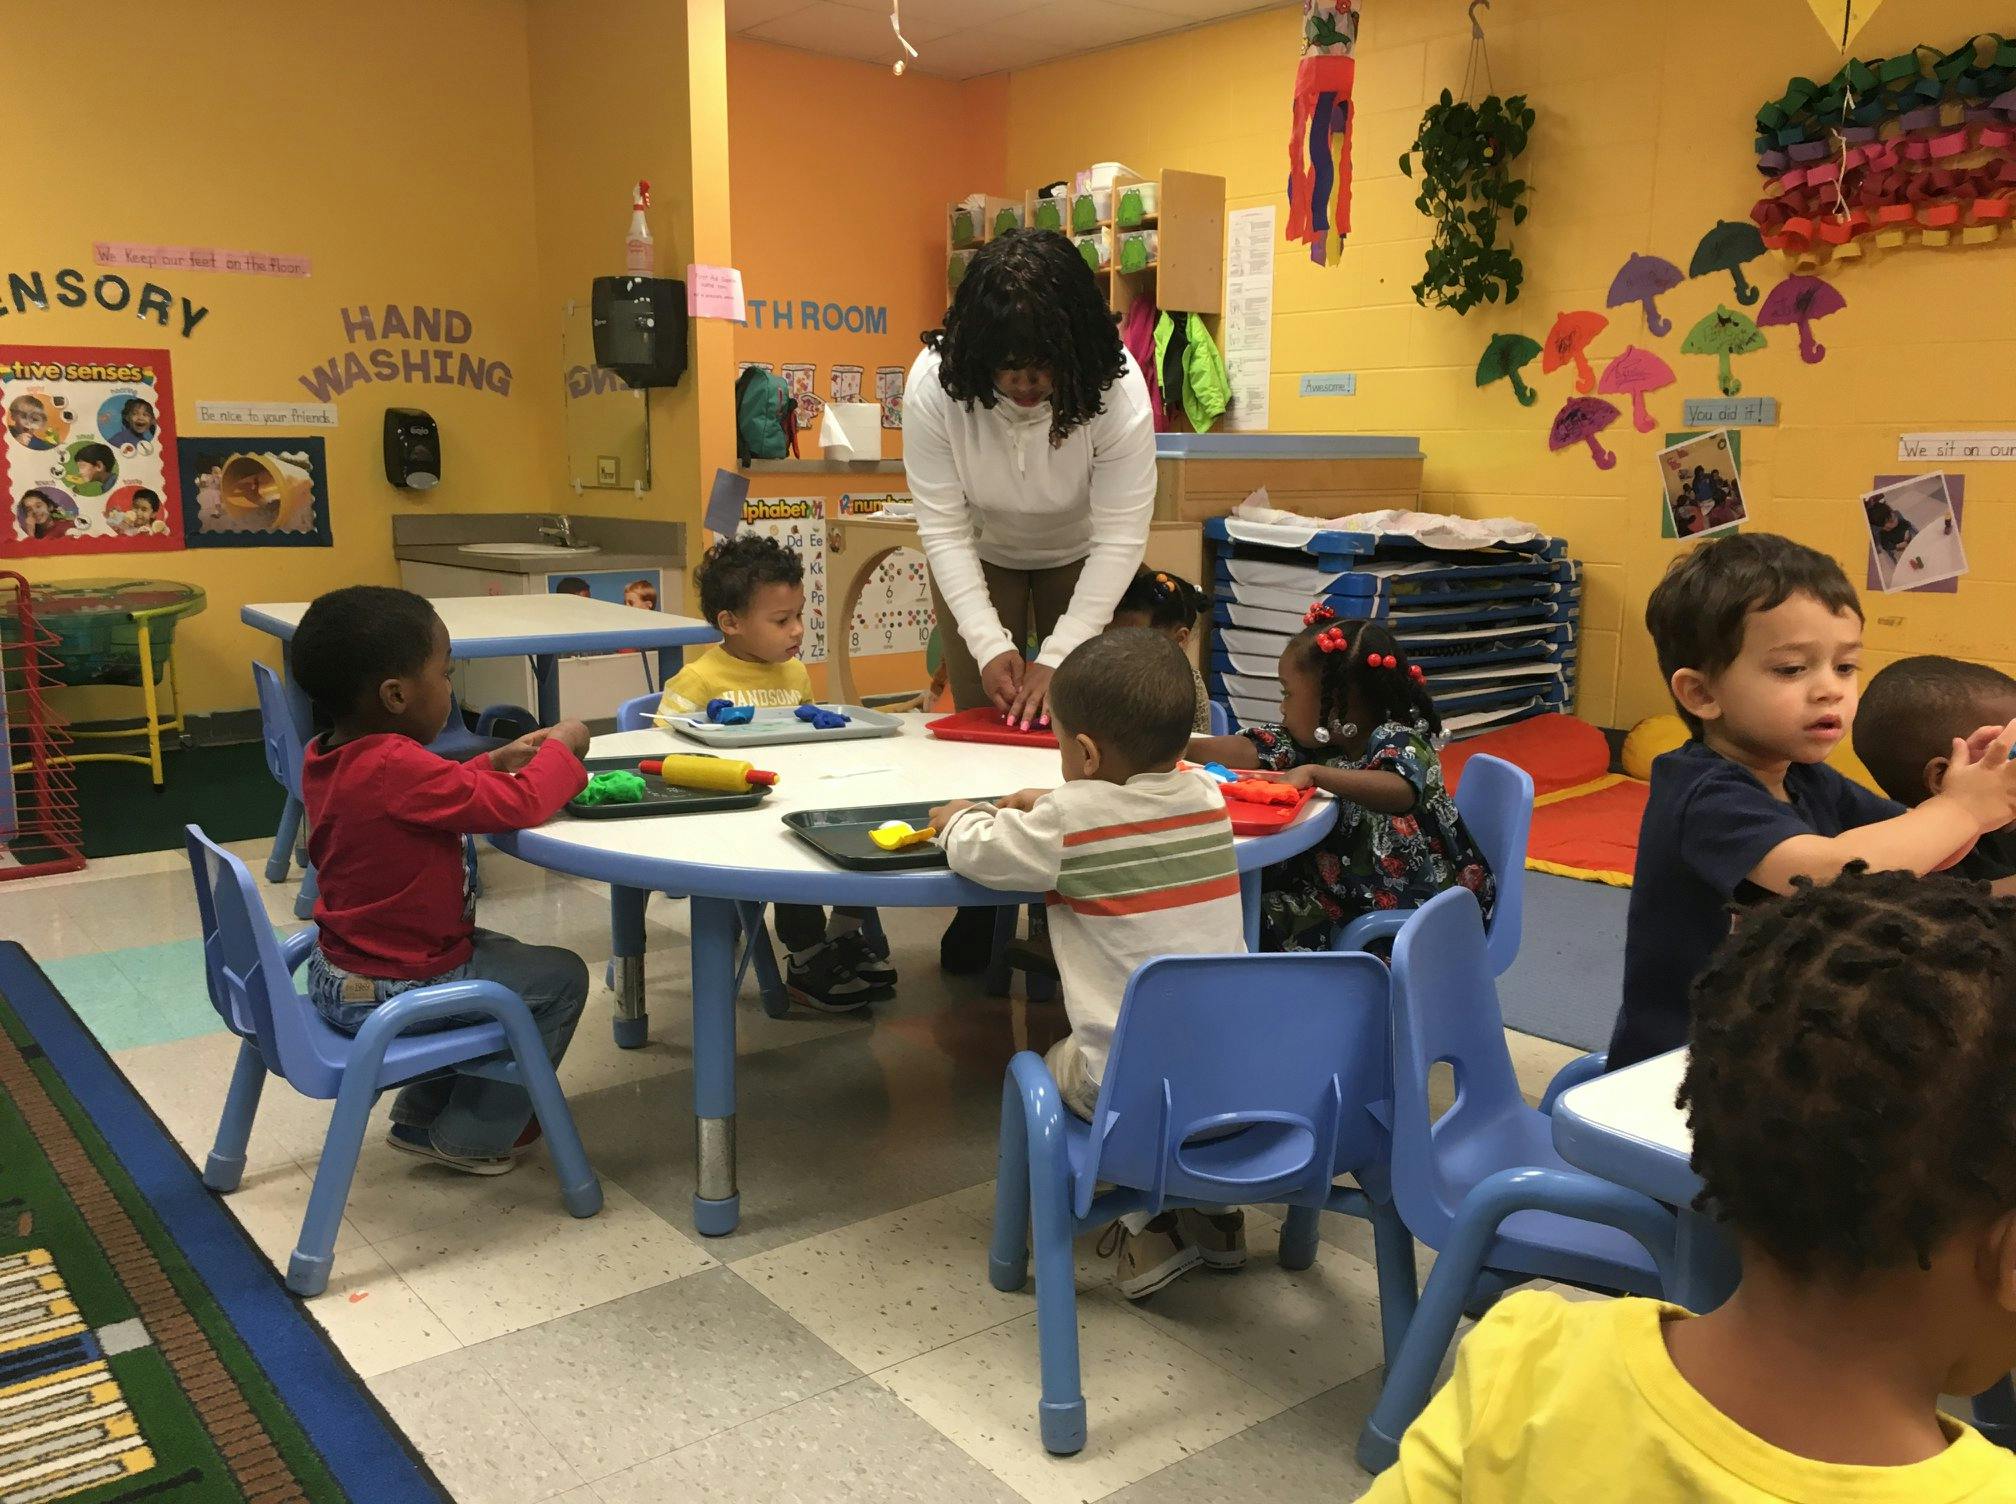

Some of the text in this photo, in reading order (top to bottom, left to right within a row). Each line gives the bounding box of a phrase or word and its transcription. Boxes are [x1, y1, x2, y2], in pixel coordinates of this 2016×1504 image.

[96, 245, 116, 261] We
[162, 256, 184, 267] our
[189, 251, 216, 268] feet
[226, 259, 242, 271] on
[244, 256, 267, 272] the
[341, 304, 472, 343] HAND
[65, 364, 144, 383] senses
[298, 349, 513, 403] WASHING
[201, 406, 215, 421] Be
[220, 411, 242, 422] nice
[248, 409, 260, 422] to
[263, 413, 287, 426] your
[1689, 405, 1712, 426] You
[1719, 405, 1737, 420] did
[1904, 440, 2016, 457] We sit on our
[741, 499, 807, 525] lphabet
[787, 534, 823, 547] Dd Ee
[810, 562, 824, 574] Kk
[811, 591, 825, 605] Pp
[885, 583, 926, 598] 6 7
[810, 618, 825, 630] Uu
[852, 627, 929, 646] 8 9 10
[811, 645, 825, 657] Zz
